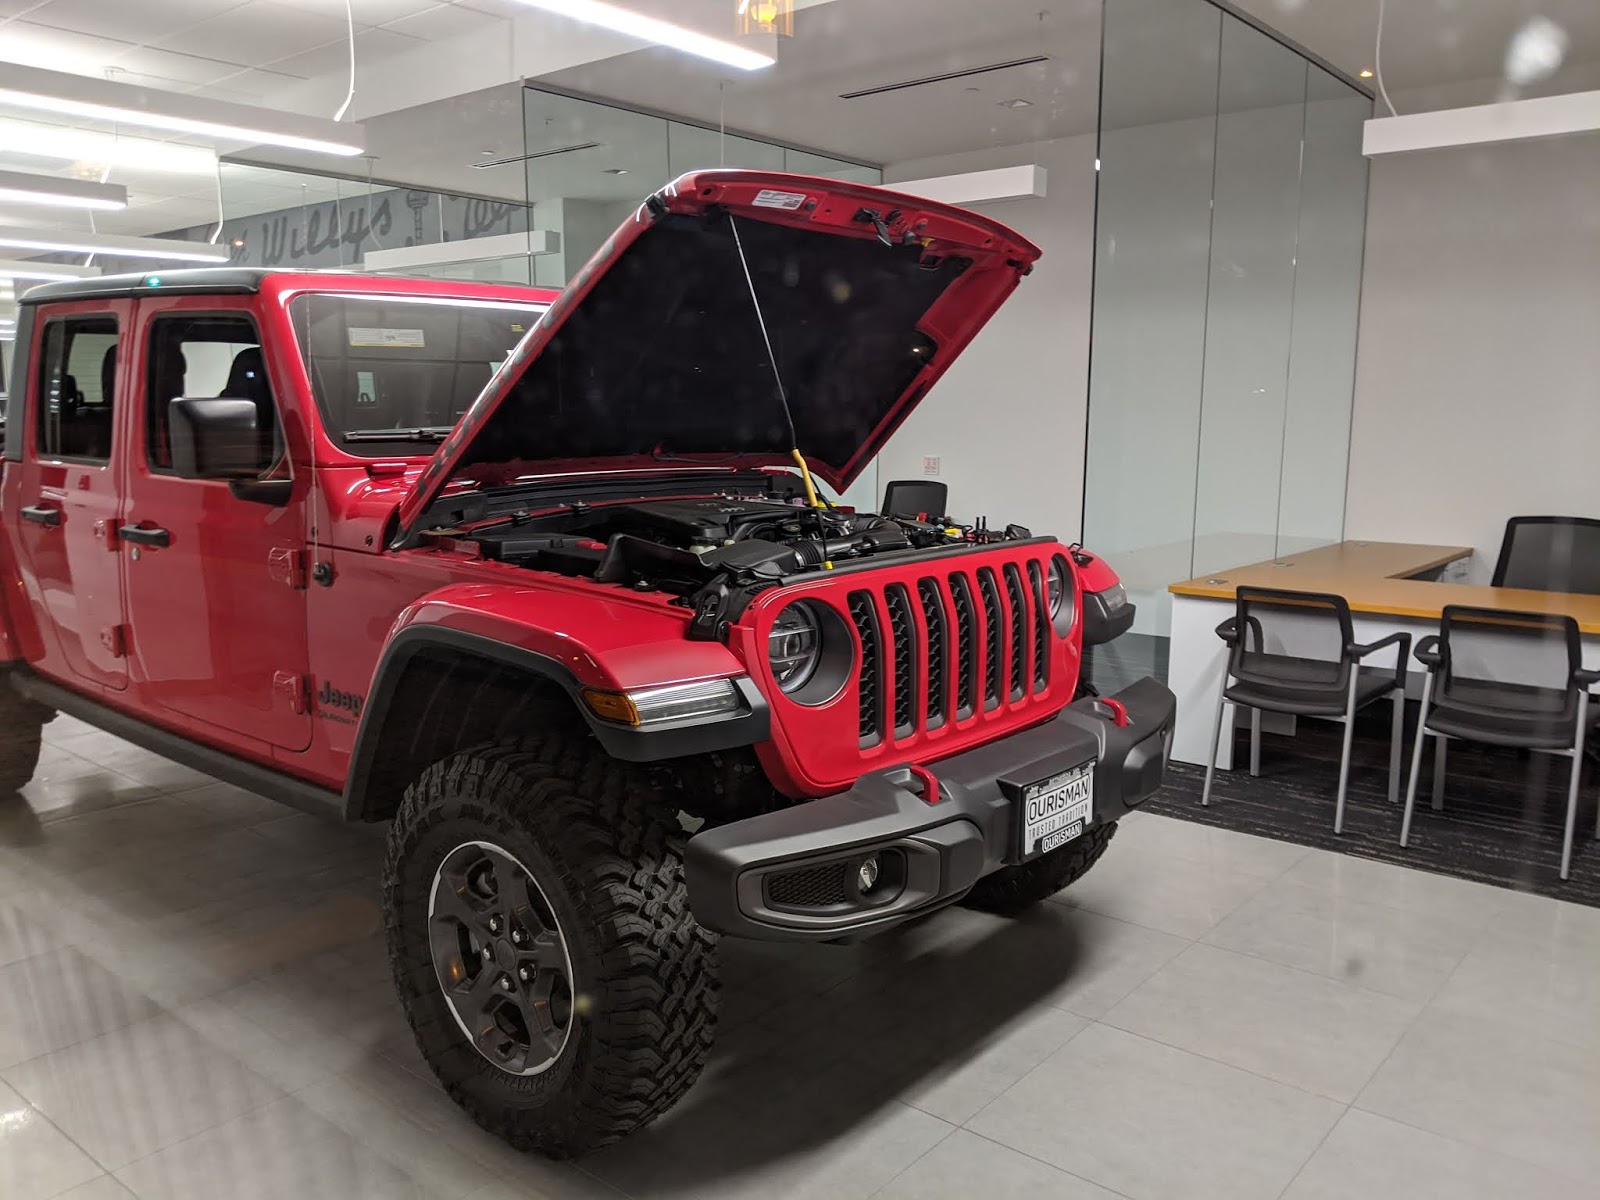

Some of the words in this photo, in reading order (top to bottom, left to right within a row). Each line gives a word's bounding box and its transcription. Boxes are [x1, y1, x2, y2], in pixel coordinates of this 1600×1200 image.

[262, 198, 392, 265] Willys
[317, 680, 362, 717] Jeep
[1029, 779, 1089, 821] OURISMAN
[1028, 819, 1056, 840] TRUSTED
[1059, 803, 1088, 824] TRADITION
[1044, 822, 1081, 851] OURISMAN
